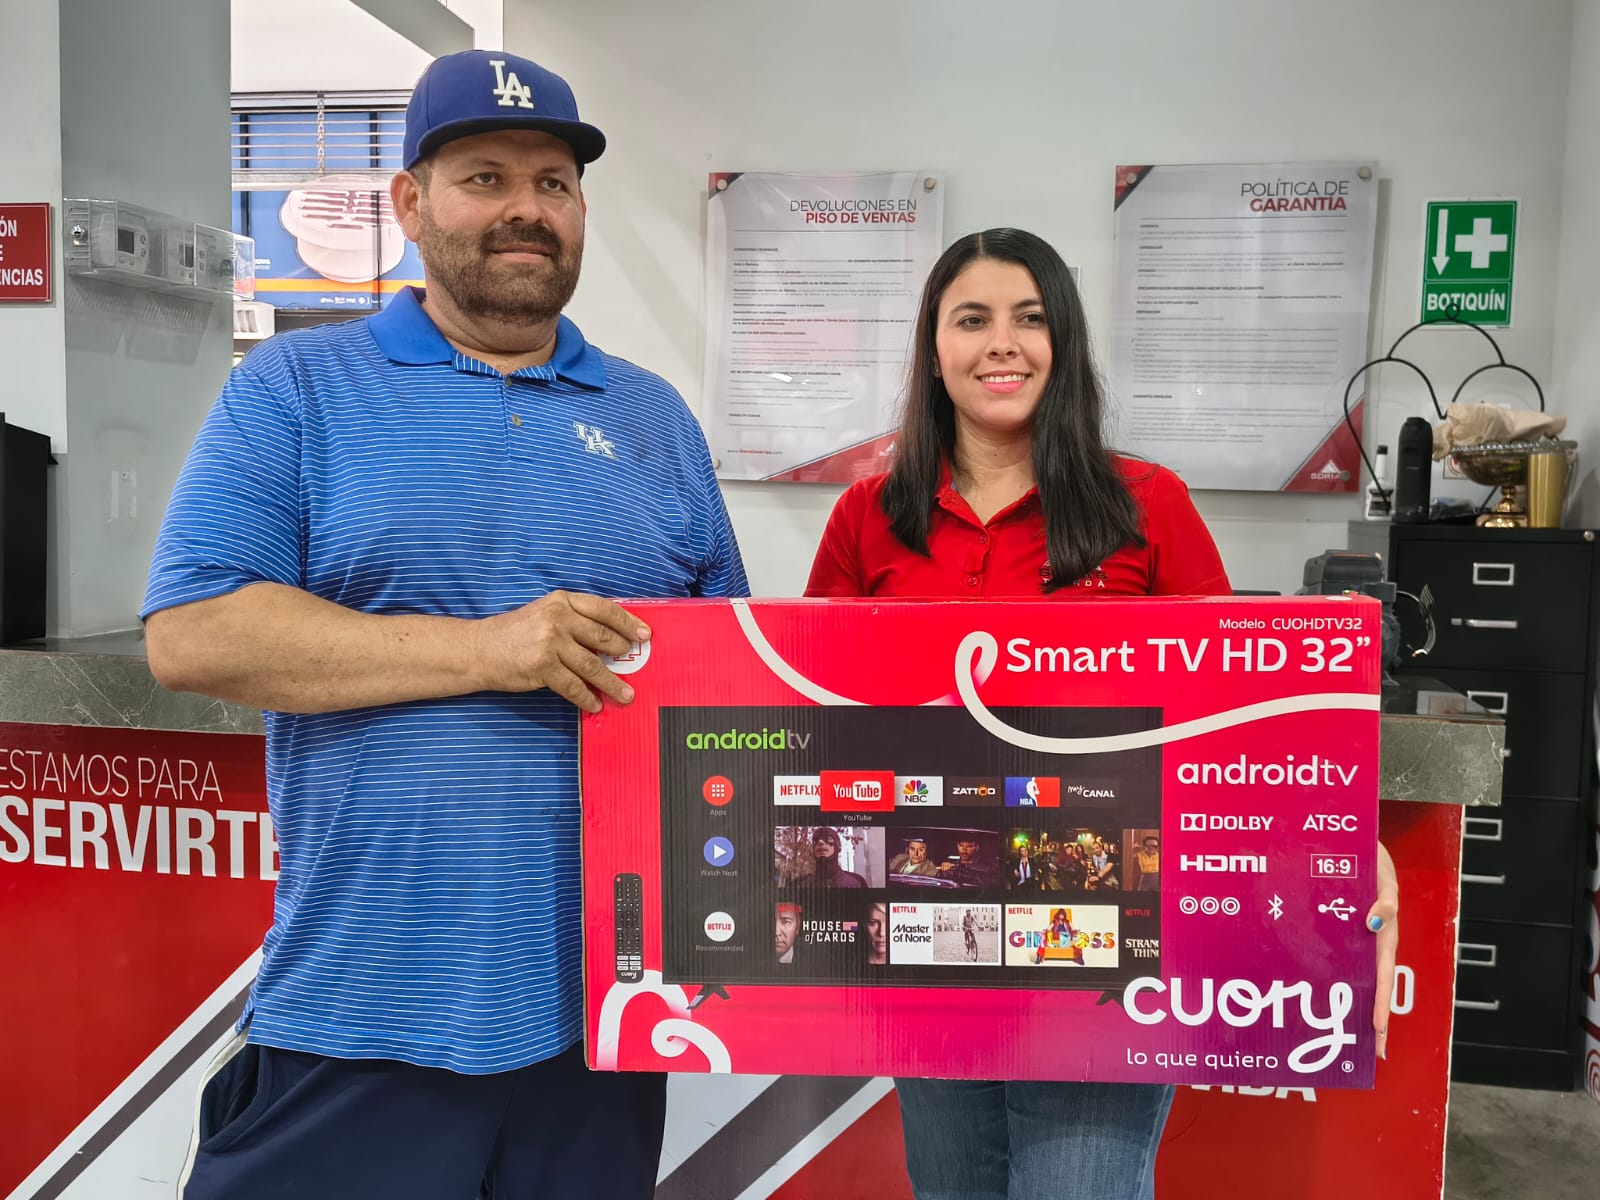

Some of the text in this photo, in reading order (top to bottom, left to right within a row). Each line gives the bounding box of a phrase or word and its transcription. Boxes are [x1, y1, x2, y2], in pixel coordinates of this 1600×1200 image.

[489, 60, 534, 108] LA
[1241, 179, 1350, 196] POLÍTICA DE
[790, 199, 917, 212] DEVOLUCIONES EN
[1250, 194, 1347, 212] GARANTÍA
[806, 211, 916, 224] PISO DE VENTAS
[1427, 289, 1506, 311] BOTIQUÍN
[573, 420, 619, 460] UK
[1219, 617, 1362, 630] Modelo CUOHDTV32
[1006, 638, 1135, 673] Smart
[1147, 638, 1210, 672] TV
[1223, 638, 1287, 672] HD
[137, 756, 223, 802] PARA
[780, 784, 821, 797] NETFLIX
[952, 785, 996, 796] ZATTOO
[904, 794, 927, 803] NBC
[1019, 797, 1034, 806] NBA
[709, 808, 727, 817] Apps
[843, 814, 873, 822] YouTube
[1210, 816, 1274, 831] DOLBY
[1302, 814, 1358, 832] ATSC
[1180, 855, 1267, 873] HDMI
[1316, 859, 1351, 874] 16:9
[700, 869, 739, 877] Watch Next
[892, 906, 917, 914] NETFLIX
[1008, 907, 1033, 915] NETFLIX
[707, 923, 732, 931] NETFLIX
[802, 920, 841, 931] HOUSE
[892, 924, 930, 934] Master
[804, 931, 855, 944] of CARDS
[893, 933, 931, 943] of None
[1125, 938, 1159, 948] STRAN
[696, 944, 744, 952] Recommended
[1133, 949, 1159, 958] THIN
[1127, 1048, 1279, 1069] lo que quiero
